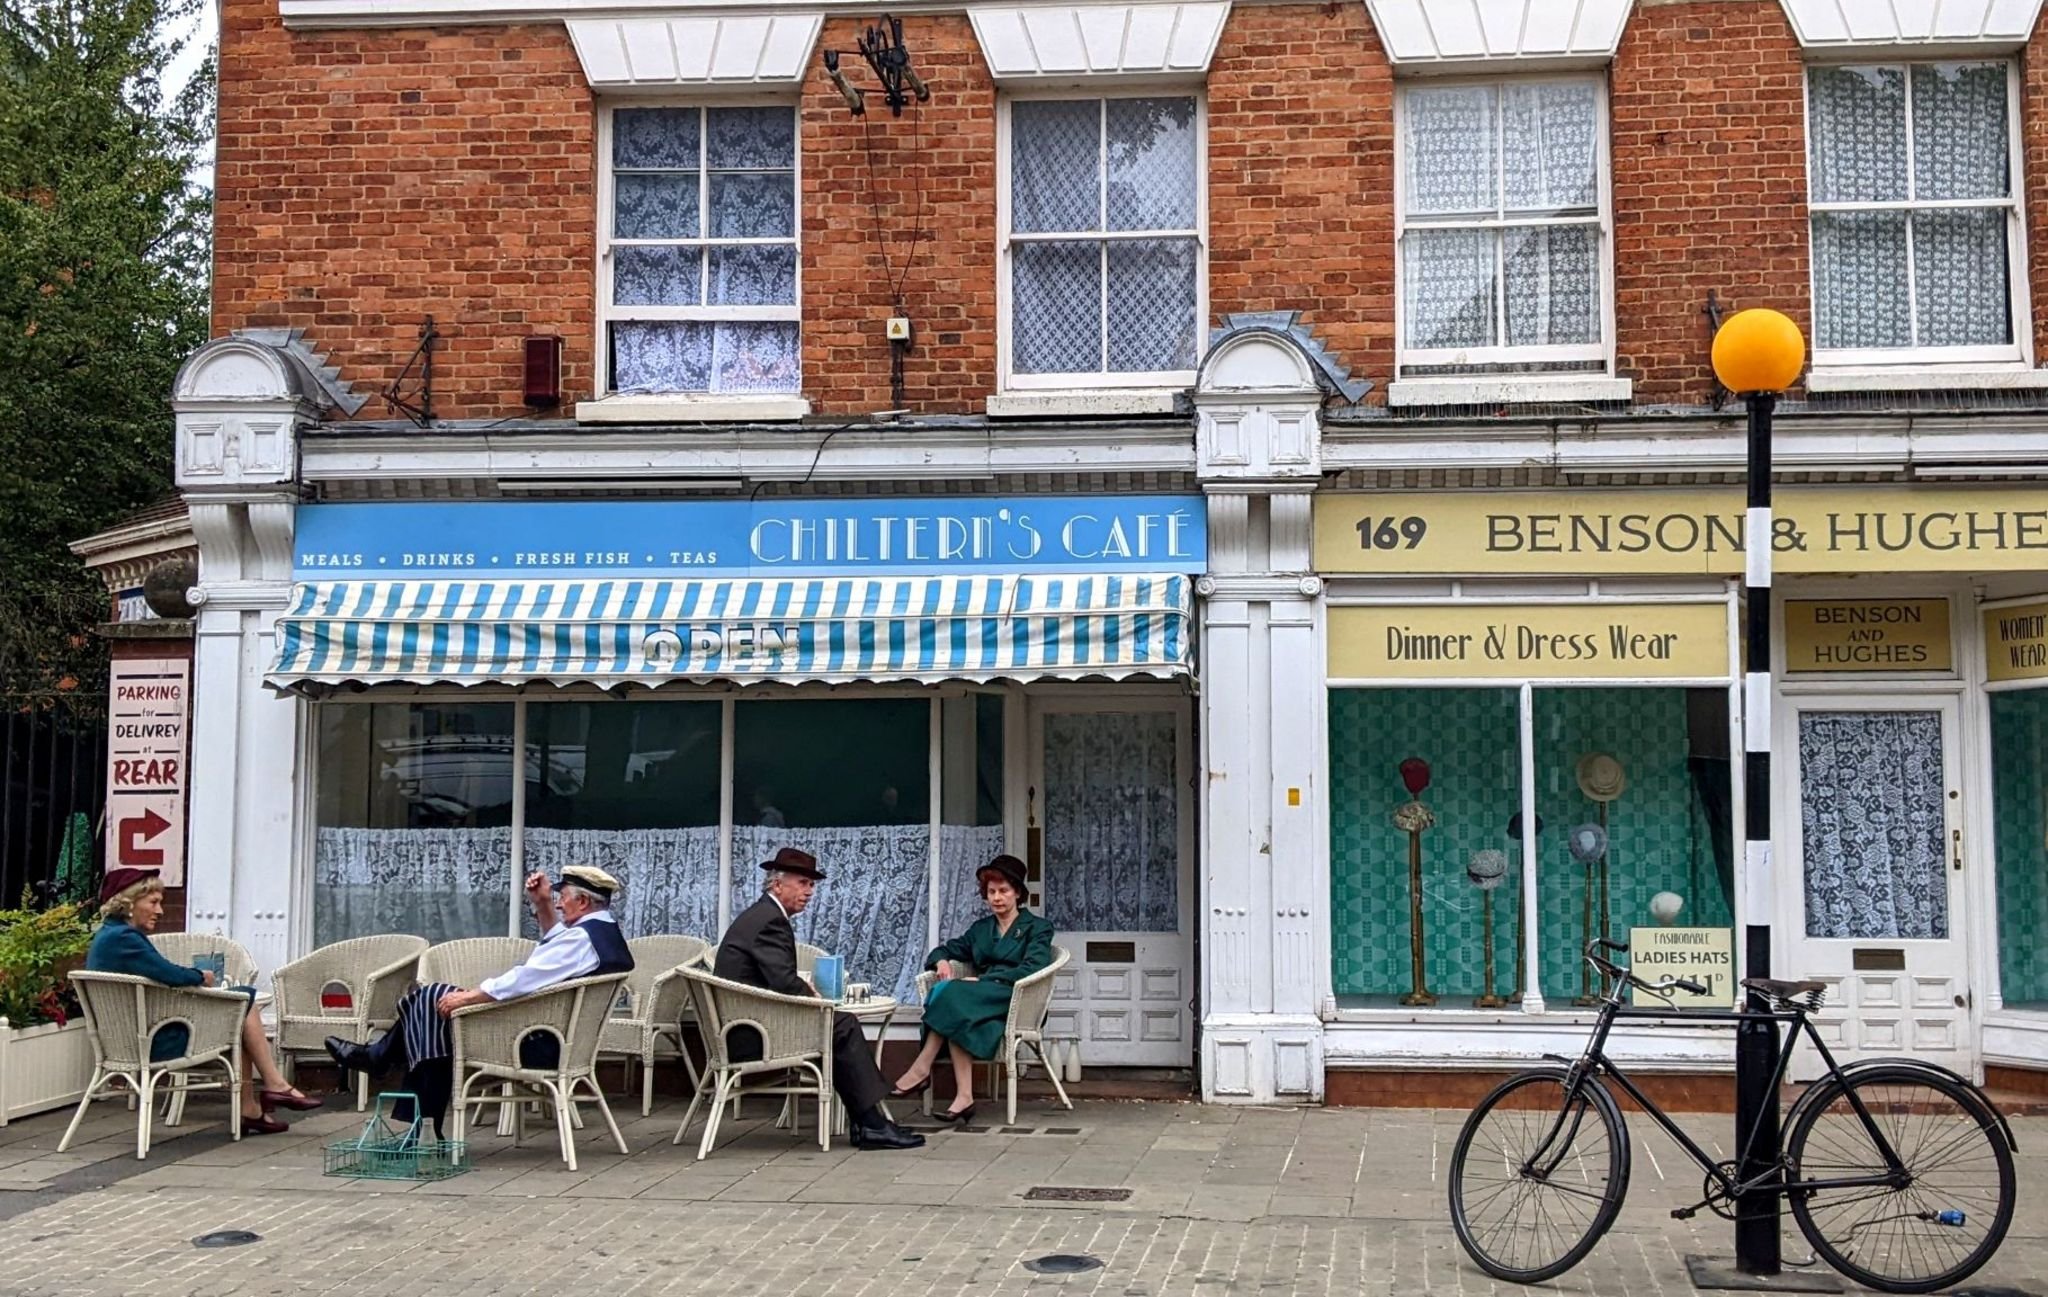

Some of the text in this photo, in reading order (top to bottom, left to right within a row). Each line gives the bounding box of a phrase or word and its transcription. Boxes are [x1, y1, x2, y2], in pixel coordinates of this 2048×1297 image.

[749, 507, 1193, 563] CHILTERN'S CAFÉ
[1355, 515, 1427, 551] 169
[1485, 513, 1747, 553] BENSON
[1770, 517, 1808, 552] &
[302, 552, 718, 567] MEALS DRINKS FRESH FISH TEAS
[1815, 606, 1921, 624] BENSON
[1386, 623, 1678, 660] Dinner & Dress Wear
[1847, 629, 1884, 642] AND
[642, 628, 800, 666] OPEN
[1815, 645, 1927, 663] HUGHES
[2010, 643, 2046, 668] WEAR
[117, 685, 181, 701] PARKING
[141, 708, 155, 717] for
[115, 724, 181, 738] DELIVREY
[142, 745, 151, 754] at
[113, 758, 180, 785] REAR
[1654, 932, 1710, 945] FASHIONABLE
[1634, 951, 1729, 964] LADIES HATS
